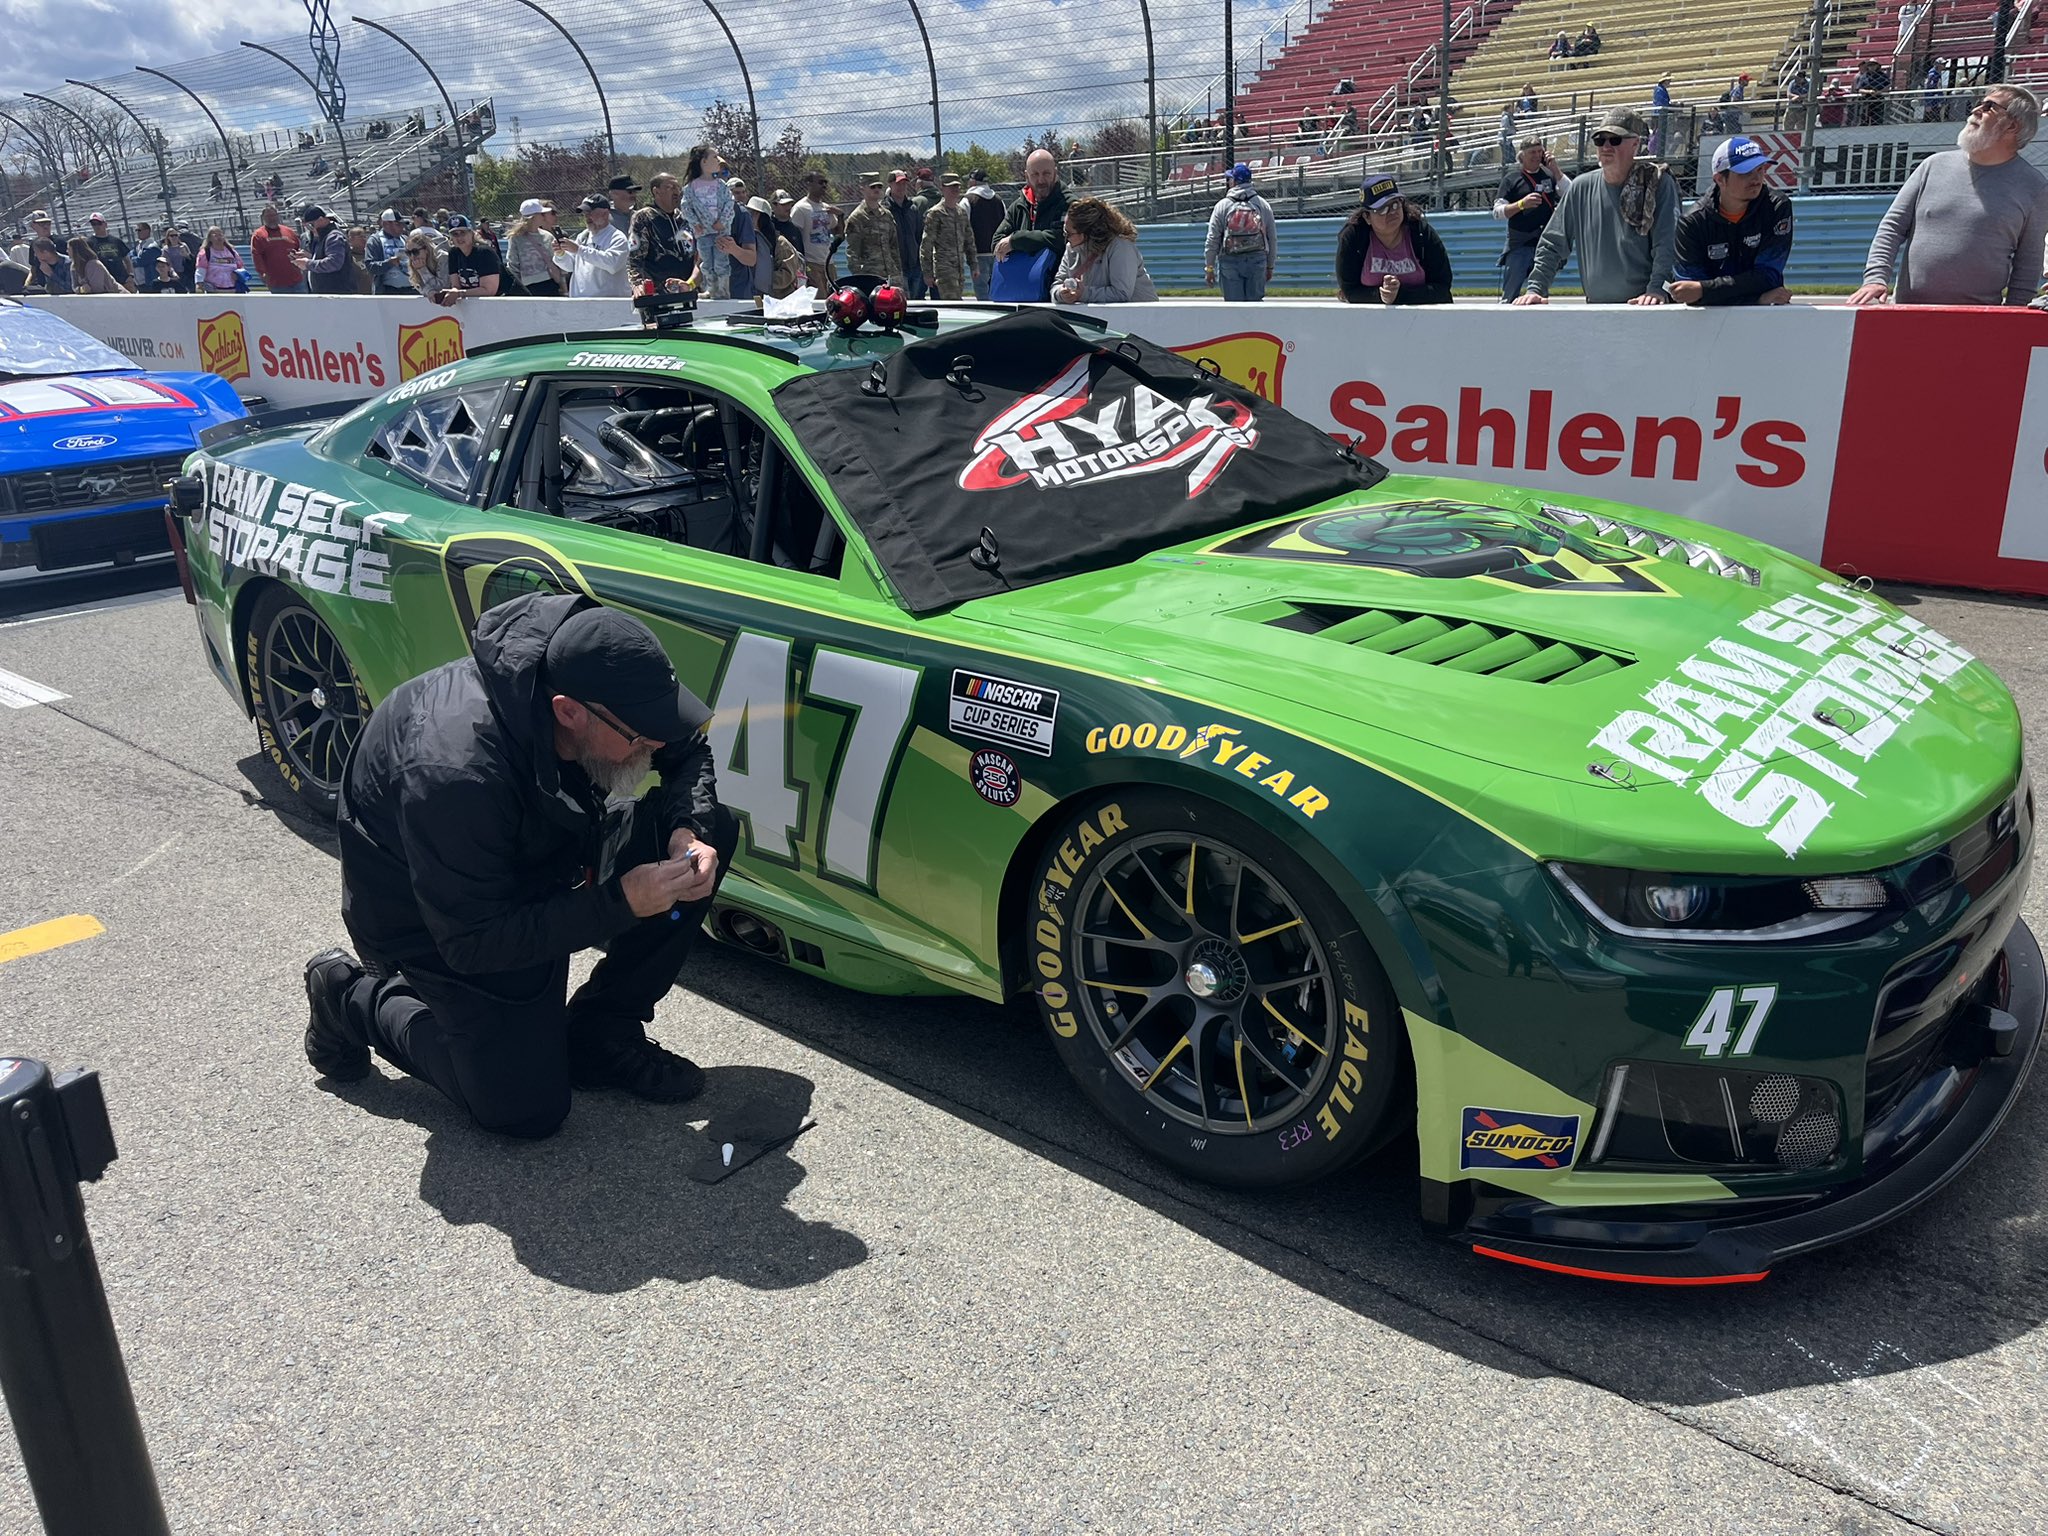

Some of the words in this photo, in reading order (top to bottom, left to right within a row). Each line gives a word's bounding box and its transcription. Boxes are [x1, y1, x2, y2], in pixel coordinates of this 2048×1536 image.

[102, 336, 185, 359] WELLIVER.COM
[201, 323, 243, 373] Sahlen's
[258, 335, 386, 388] Sahlen's
[566, 351, 677, 371] STENHOUSE
[66, 436, 106, 448] Ford
[984, 383, 1228, 472] HYAK
[1028, 413, 1251, 488] MOTORSPS
[1327, 380, 1807, 488] Sahlen's
[210, 460, 278, 520] RAM
[208, 506, 395, 604] STORAGE
[962, 705, 991, 726] CUP
[990, 712, 1040, 738] SERIES
[983, 681, 1043, 712] NASCAR
[1587, 636, 1812, 788] RAM
[706, 628, 921, 888] 47
[1695, 615, 1976, 860] STORAGE
[976, 753, 1014, 776] NASCAR
[983, 770, 1008, 785] 250
[975, 779, 1016, 802] SALUTES
[1684, 984, 1778, 1058] 47
[1315, 997, 1371, 1141] EAGLE
[1278, 1119, 1313, 1151] RF3
[1470, 1131, 1572, 1153] SUNOCO
